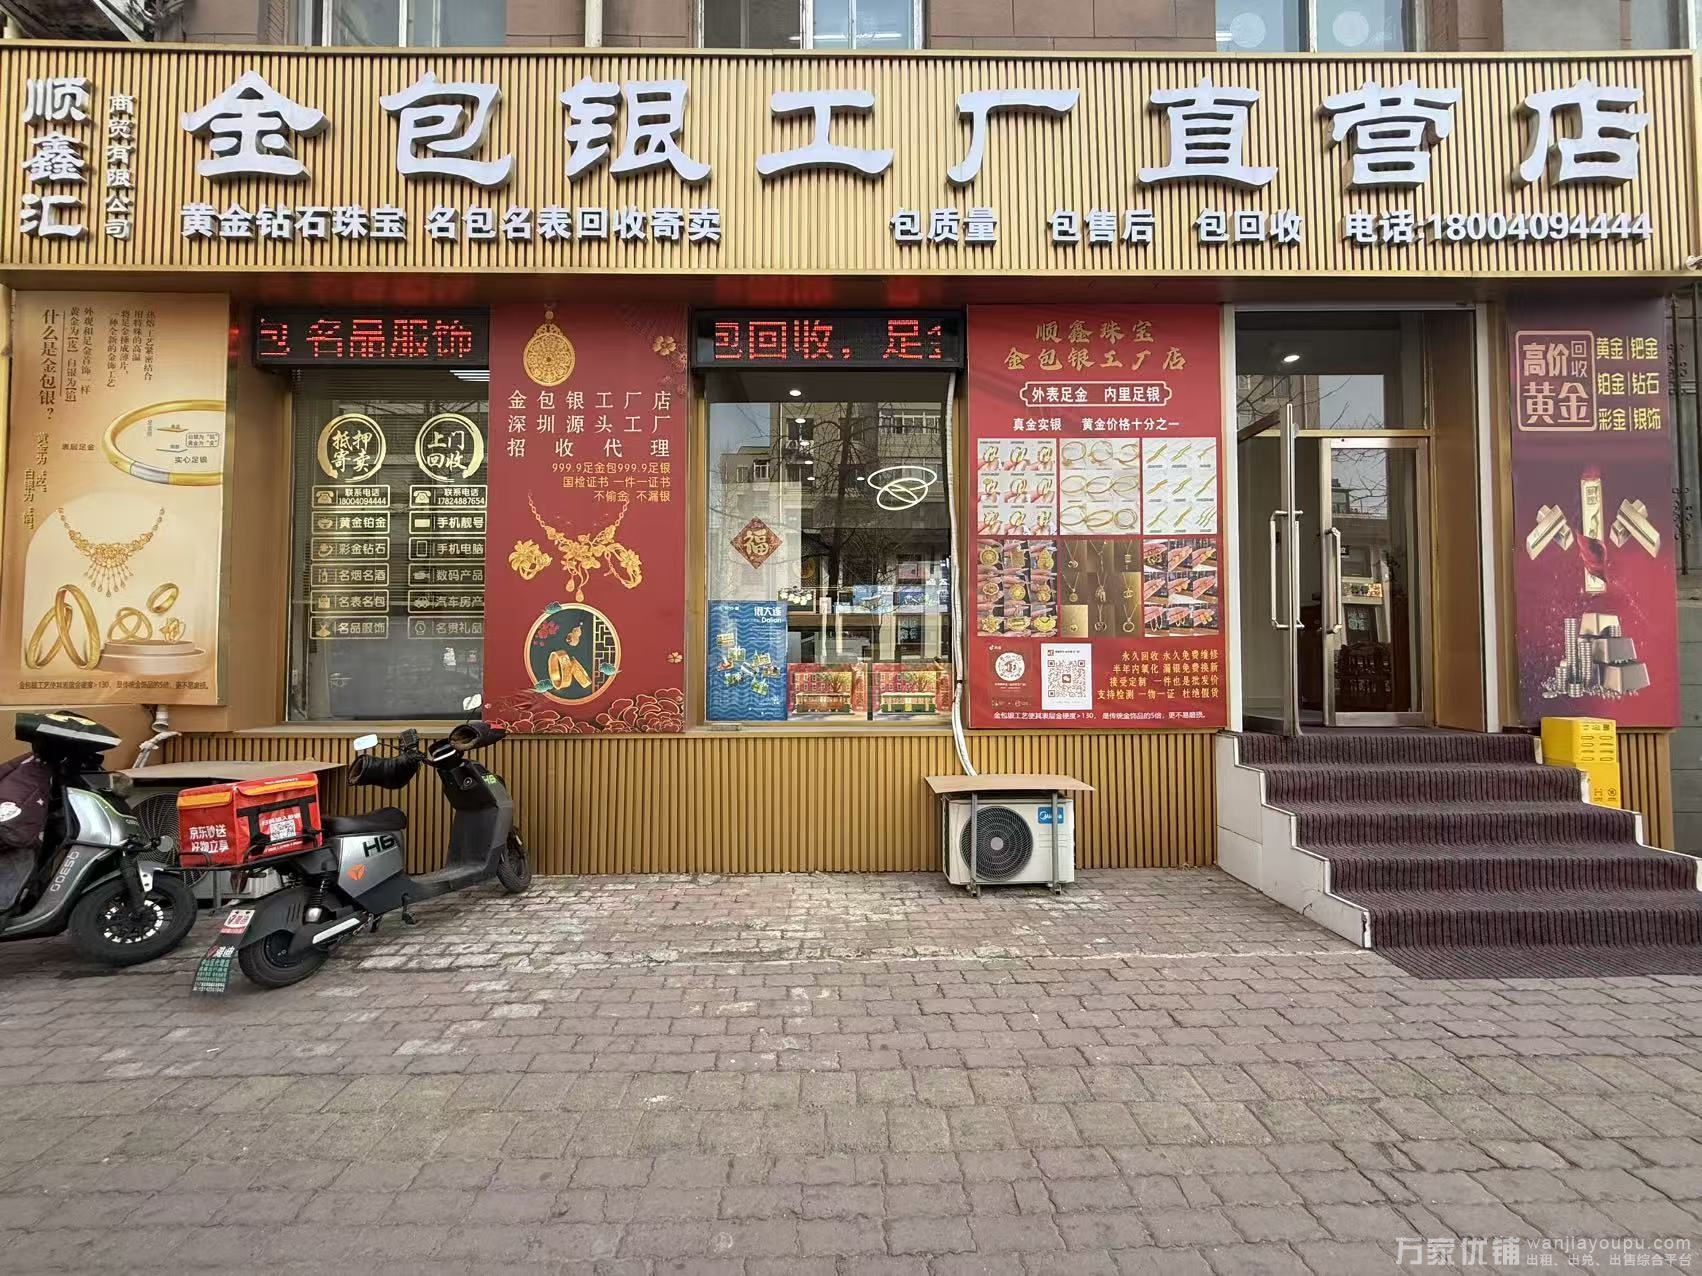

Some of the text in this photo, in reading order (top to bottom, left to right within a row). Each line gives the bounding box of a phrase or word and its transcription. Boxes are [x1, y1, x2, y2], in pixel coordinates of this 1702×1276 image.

[181, 71, 1648, 189] 金包银工厂直营店
[20, 76, 90, 240] 顺鑫汇
[104, 94, 136, 241] 商贸有限公司
[181, 203, 1653, 246] 黄金钻石珠宝 名包名表回收寄卖 包质量 包售后 包回收 电话:18004094444
[305, 318, 472, 358] 名品服饰
[1035, 320, 1155, 344] 顺鑫珠宝
[1596, 337, 1659, 360] 黄金 钯金
[1003, 347, 1188, 371] 金包银工厂店
[1523, 342, 1569, 377] 高价
[1571, 340, 1588, 378] 回收
[1597, 373, 1660, 395] 铂金 钻石
[507, 390, 672, 411] 金包银工厂店
[1031, 386, 1160, 403] 外表足金 内里足银
[1523, 382, 1591, 424] 黄金
[507, 414, 672, 434] 深圳源头工厂
[1013, 417, 1180, 432] 真金实银 黄金价格十分之一
[1598, 408, 1661, 431] 彩金 银饰
[331, 429, 374, 451] 抵押
[426, 430, 466, 451] 上门
[507, 438, 670, 458] 招收代理
[330, 450, 371, 473] 寄卖
[426, 451, 468, 472] 回收
[552, 462, 671, 474] 999.9足金包999.9足银
[563, 476, 671, 488] 国检证书 一件一证书
[344, 488, 380, 497] 联系电话
[443, 488, 479, 497] 联系电话
[594, 490, 671, 502] 不偷金 不漏银
[339, 517, 387, 529] 黄金铂金
[437, 517, 484, 529] 手机靓号
[338, 543, 386, 555] 彩金钻石
[436, 543, 483, 555] 手机电脑
[745, 529, 769, 556] 福
[338, 569, 386, 582] 名烟名酒
[436, 569, 483, 582] 数码产品
[338, 595, 385, 608] 名表名包
[436, 595, 482, 608] 汽车房产
[337, 622, 385, 635] 名品服饰
[435, 622, 482, 635] 名贵礼品
[1121, 651, 1159, 662] 永久回收
[1109, 677, 1147, 688] 接受定制
[1097, 690, 1135, 701] 支持检测
[481, 774, 497, 785] H6
[189, 824, 227, 840] 京东秒送
[191, 840, 229, 854] 好物立享
[362, 835, 395, 857] H6
